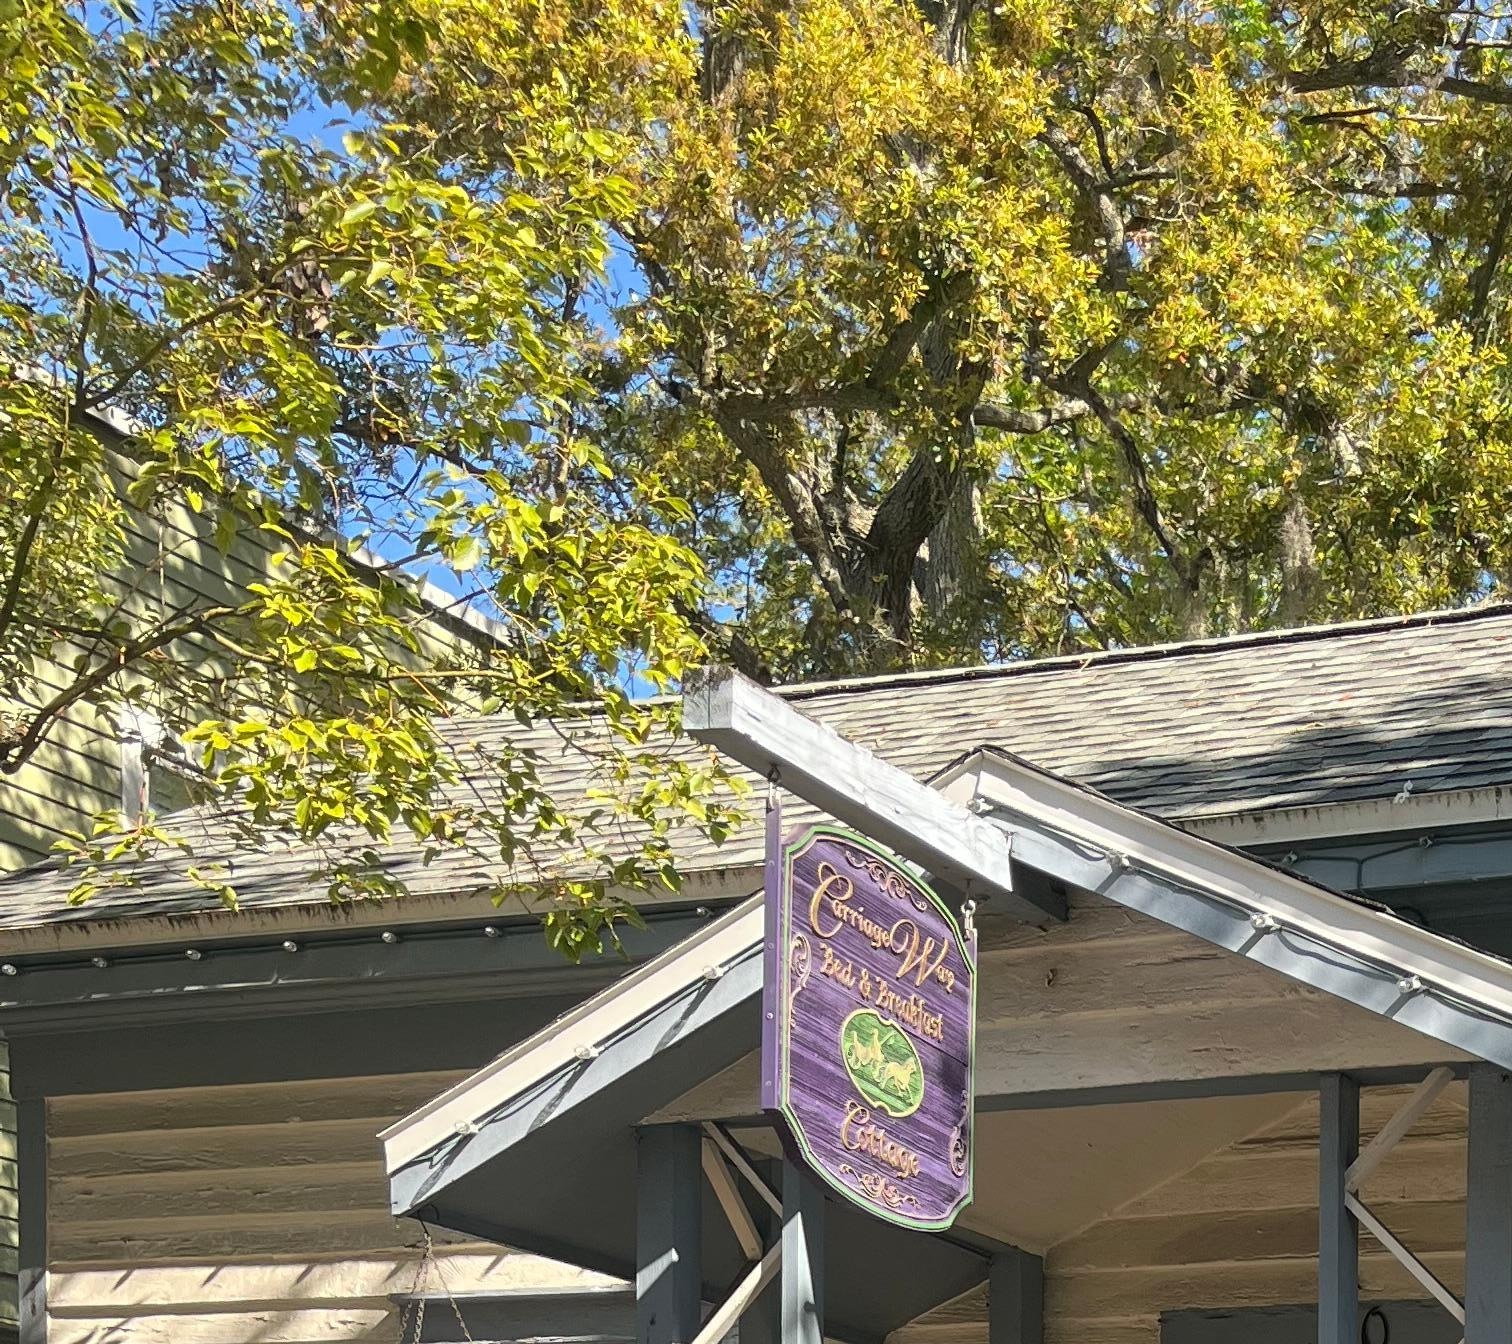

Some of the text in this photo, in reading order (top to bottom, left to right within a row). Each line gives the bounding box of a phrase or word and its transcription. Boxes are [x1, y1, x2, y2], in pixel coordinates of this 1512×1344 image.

[809, 862, 956, 994] Carriage Way
[820, 943, 944, 1043] Bed & Breakfast
[840, 1101, 920, 1178] Cottage
